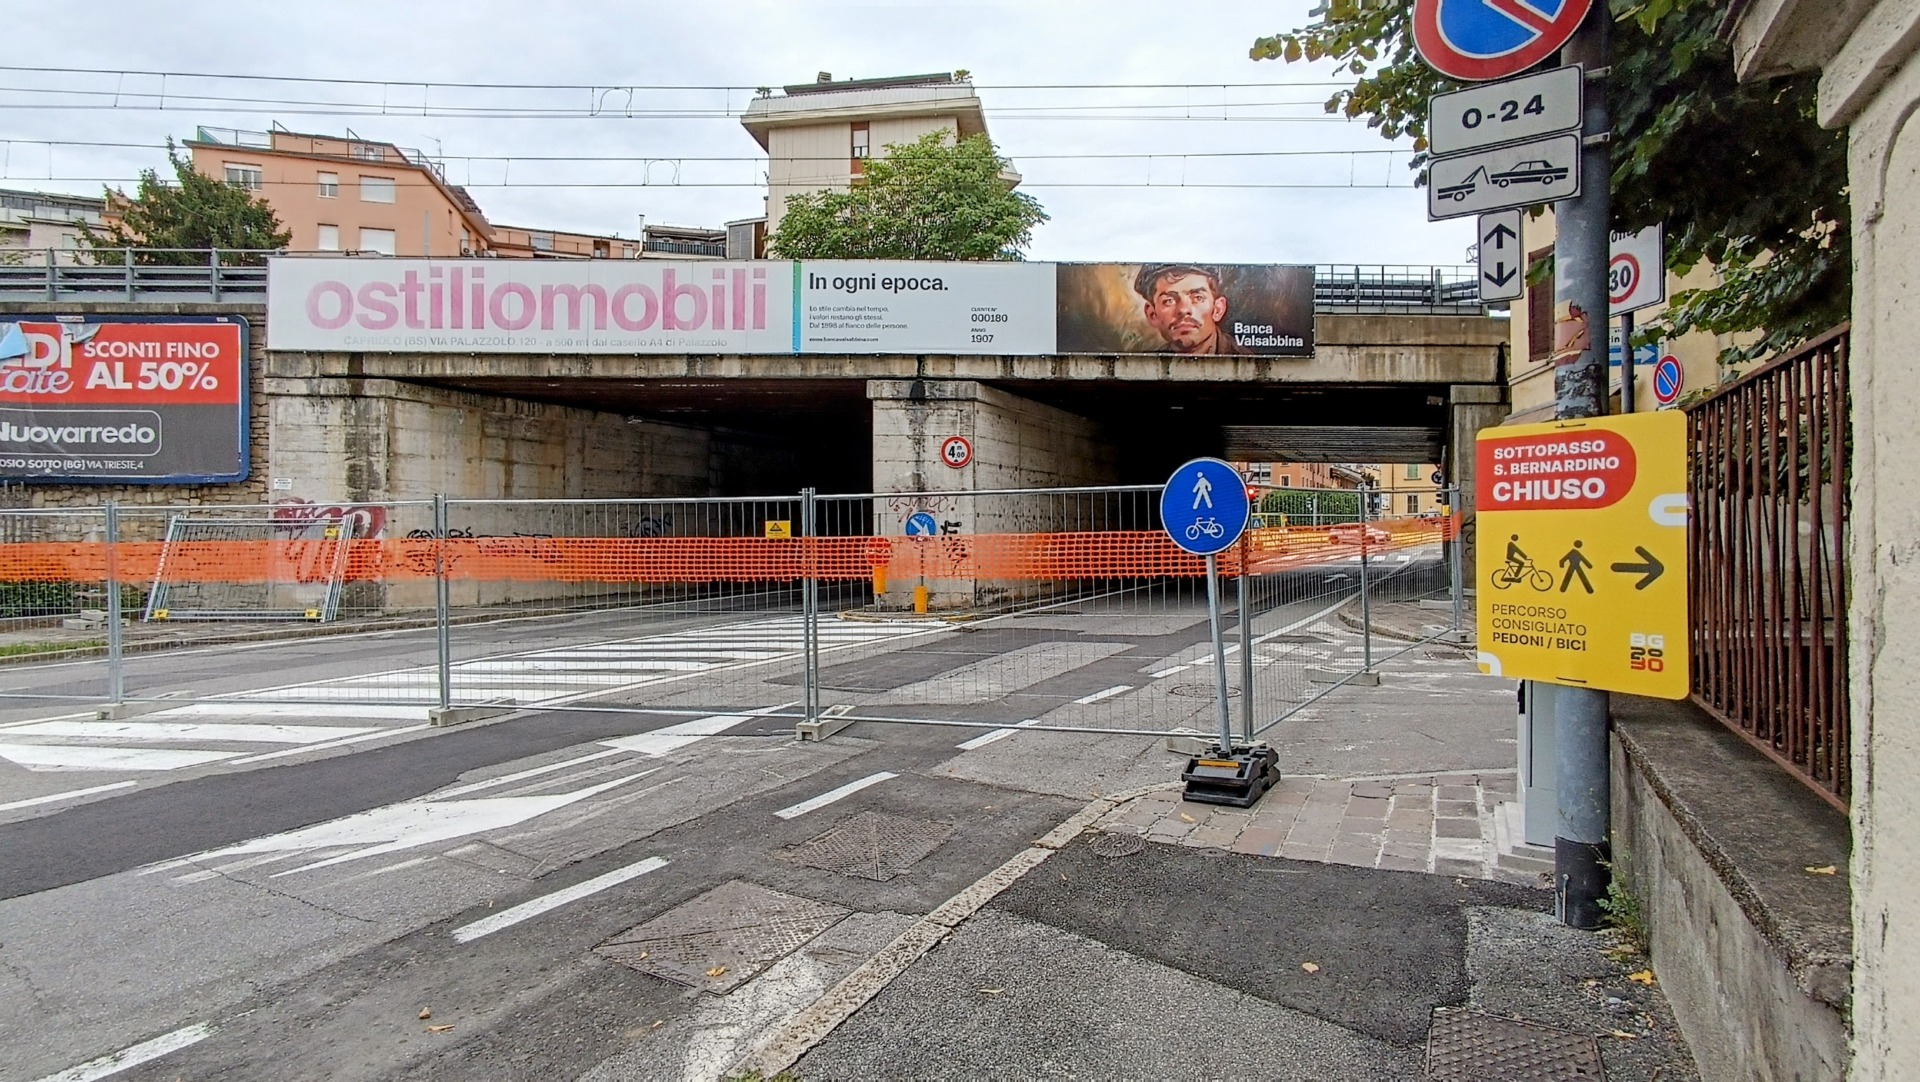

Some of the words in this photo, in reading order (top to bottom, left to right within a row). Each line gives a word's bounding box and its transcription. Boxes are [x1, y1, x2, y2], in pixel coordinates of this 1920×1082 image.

[1461, 94, 1545, 129] 0-24
[809, 273, 827, 290] In
[832, 273, 876, 294] ogni
[881, 276, 949, 294] epoca.
[1609, 265, 1631, 292] 30
[305, 266, 767, 332] ostiliomobili
[971, 313, 1008, 322] 000180
[1234, 322, 1273, 334] Banca
[344, 336, 401, 346] CAPRIOLO
[404, 336, 427, 347] (BS)
[430, 336, 447, 346] VIA
[555, 337, 573, 347] 500
[592, 337, 607, 347] dal
[610, 337, 647, 347] casello
[649, 337, 663, 347] A4
[665, 337, 676, 347] di
[679, 337, 727, 347] Palazzolo
[971, 334, 994, 343] 1907
[1234, 334, 1304, 347] Valsabbina
[83, 341, 161, 358] SCONTI
[167, 342, 220, 358] FINO
[85, 362, 132, 390] AL
[137, 362, 218, 390] 50%
[1493, 439, 1606, 460] SOTTOPASSO
[27, 459, 62, 469] SOTTO
[63, 459, 85, 470] (BG)
[87, 460, 102, 469] VIA
[1493, 463, 1507, 476] S.
[1510, 456, 1620, 475] BERNARDINO
[1492, 477, 1606, 502] CHIUSO
[1492, 603, 1567, 620] PERCORSO
[1492, 617, 1587, 636] CONSIGLIATO
[1492, 632, 1544, 647] PEDONI
[1556, 638, 1586, 652] BICI
[1630, 633, 1664, 649] BG
